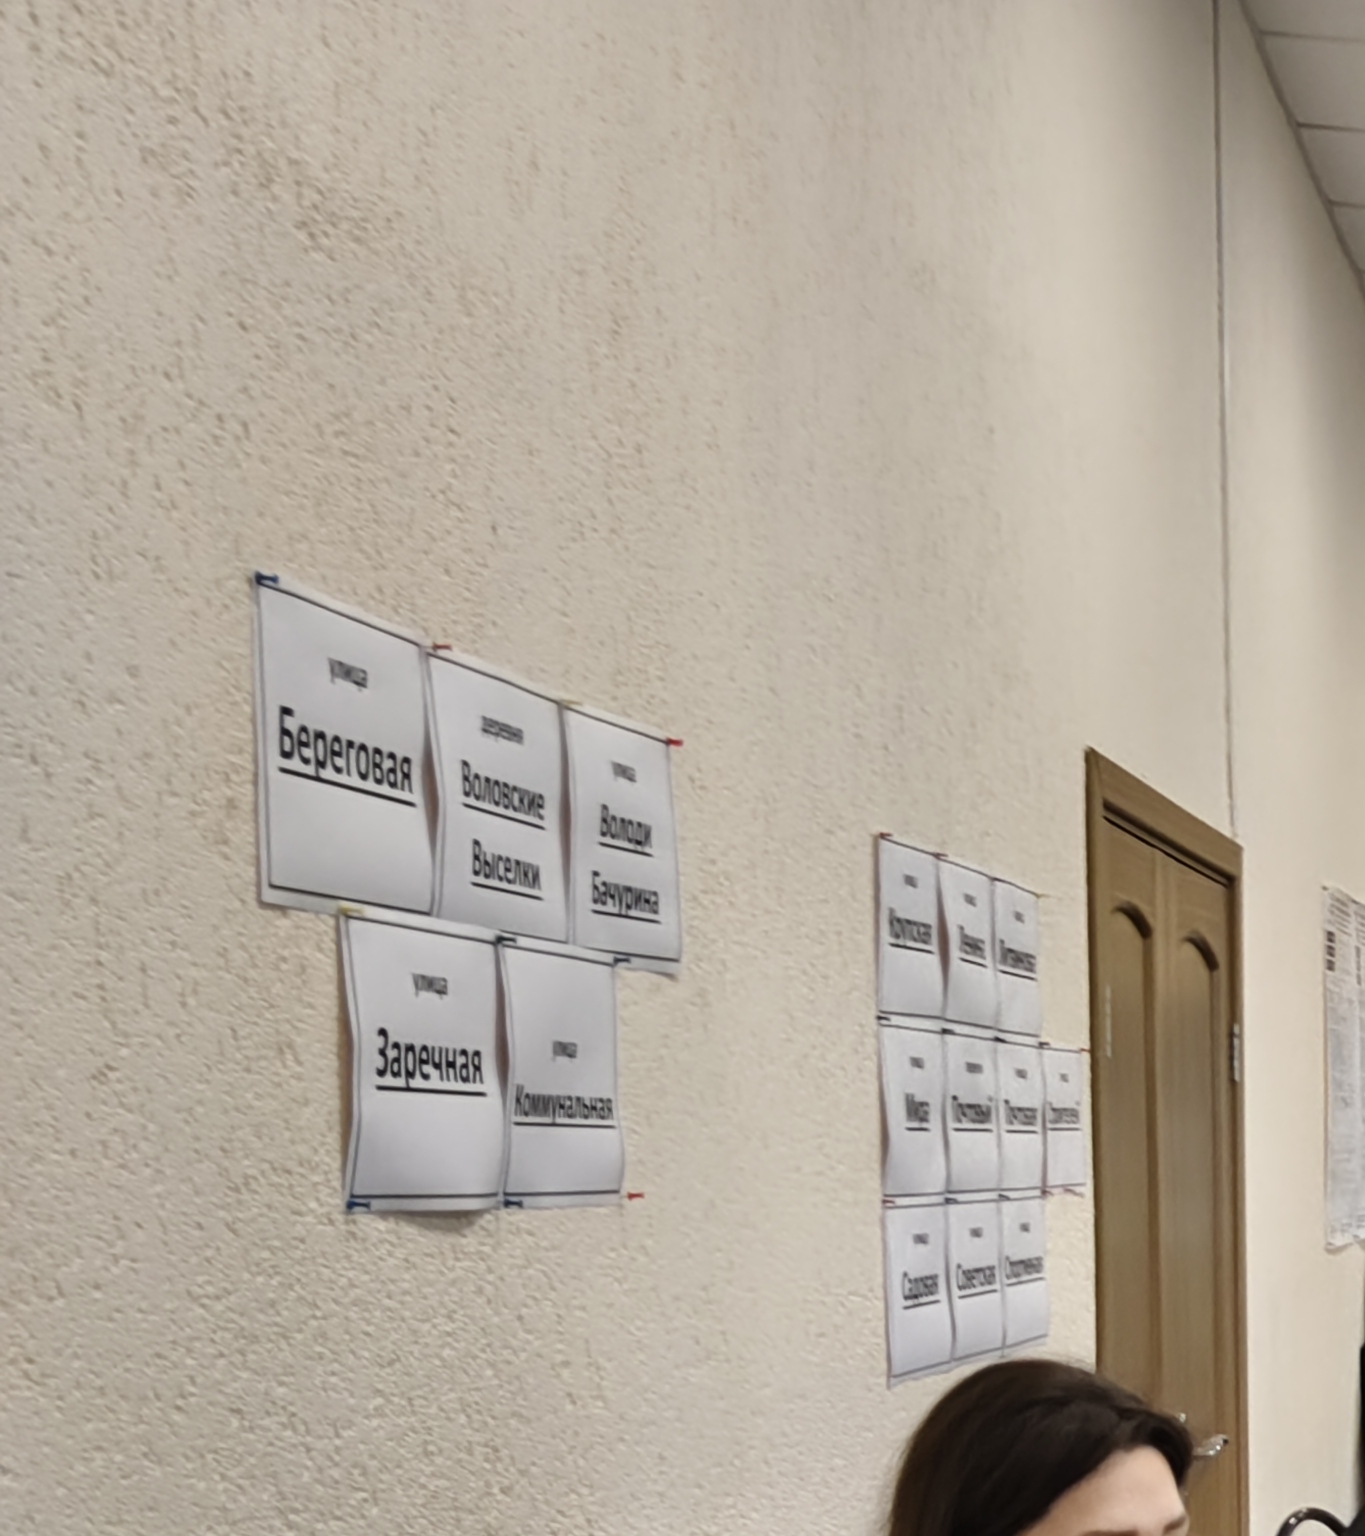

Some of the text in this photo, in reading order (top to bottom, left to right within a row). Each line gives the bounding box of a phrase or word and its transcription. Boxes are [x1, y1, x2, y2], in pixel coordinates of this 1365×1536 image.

[327, 655, 369, 691] улица
[480, 713, 525, 744] деревня
[278, 706, 414, 796] Береговая
[610, 759, 638, 784] улица
[460, 759, 546, 821] Воловские
[599, 804, 653, 850] Володи
[471, 838, 543, 891] Выселки
[591, 870, 660, 917] Бачурина
[412, 969, 449, 999] улица
[375, 1028, 485, 1089] Заречная
[551, 1036, 578, 1061] улица
[513, 1084, 614, 1124] Коммунальная
